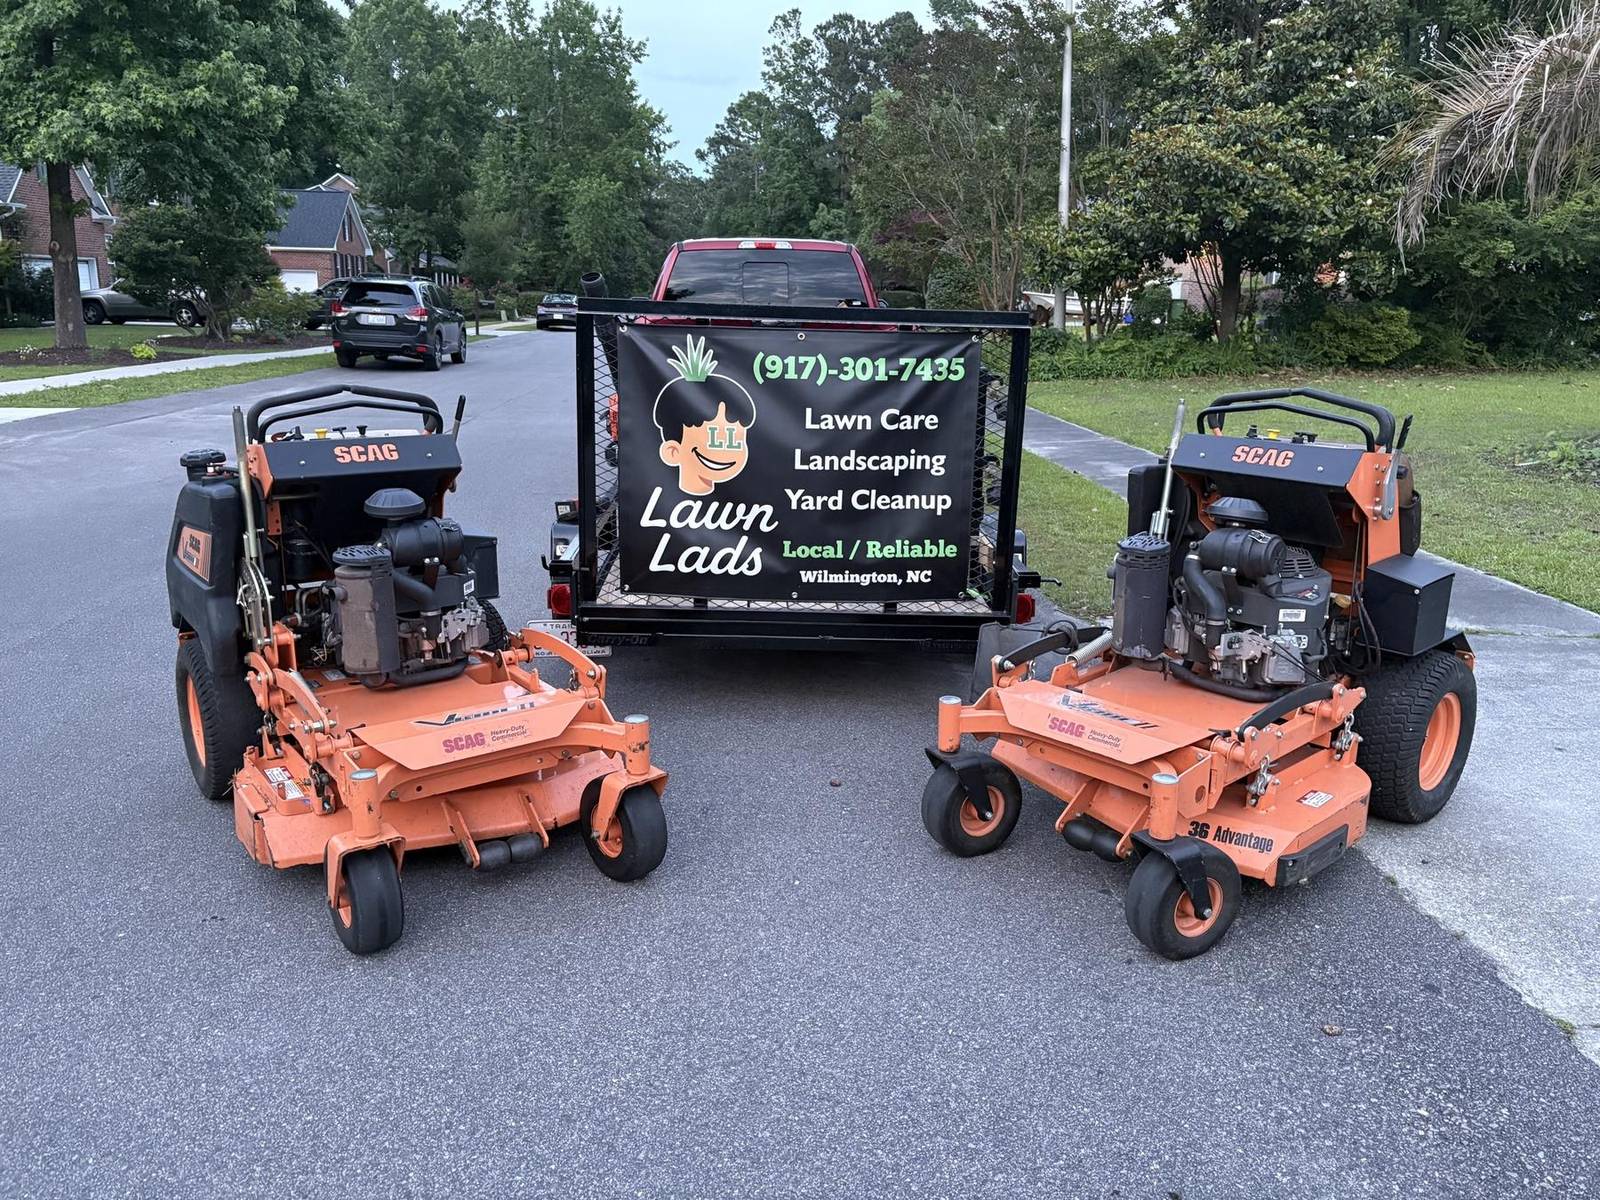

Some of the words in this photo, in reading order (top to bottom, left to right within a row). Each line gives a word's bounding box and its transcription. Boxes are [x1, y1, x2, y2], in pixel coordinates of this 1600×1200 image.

[753, 352, 966, 386] (917)-301-7435
[805, 408, 872, 430] Lawn
[881, 409, 939, 430] Care
[707, 425, 742, 450] LL
[333, 443, 399, 464] SCAG
[795, 449, 946, 476] Landscaping
[1231, 445, 1295, 468] SCAG
[640, 486, 779, 533] Lawn
[784, 489, 843, 511] Yard
[851, 489, 952, 515] Cleanup
[649, 532, 763, 576] Lads
[782, 540, 844, 559] Local
[849, 540, 861, 560] /
[866, 540, 958, 559] Reliable
[800, 570, 903, 587] Wilmington,
[906, 570, 932, 583] NC
[490, 725, 525, 736] Heavy-Duty
[1048, 717, 1086, 738] SCAG
[1090, 729, 1122, 742] Heavy-Duty
[442, 732, 486, 753] SCAG
[1187, 820, 1211, 839] 36
[1213, 825, 1274, 854] Advantage
